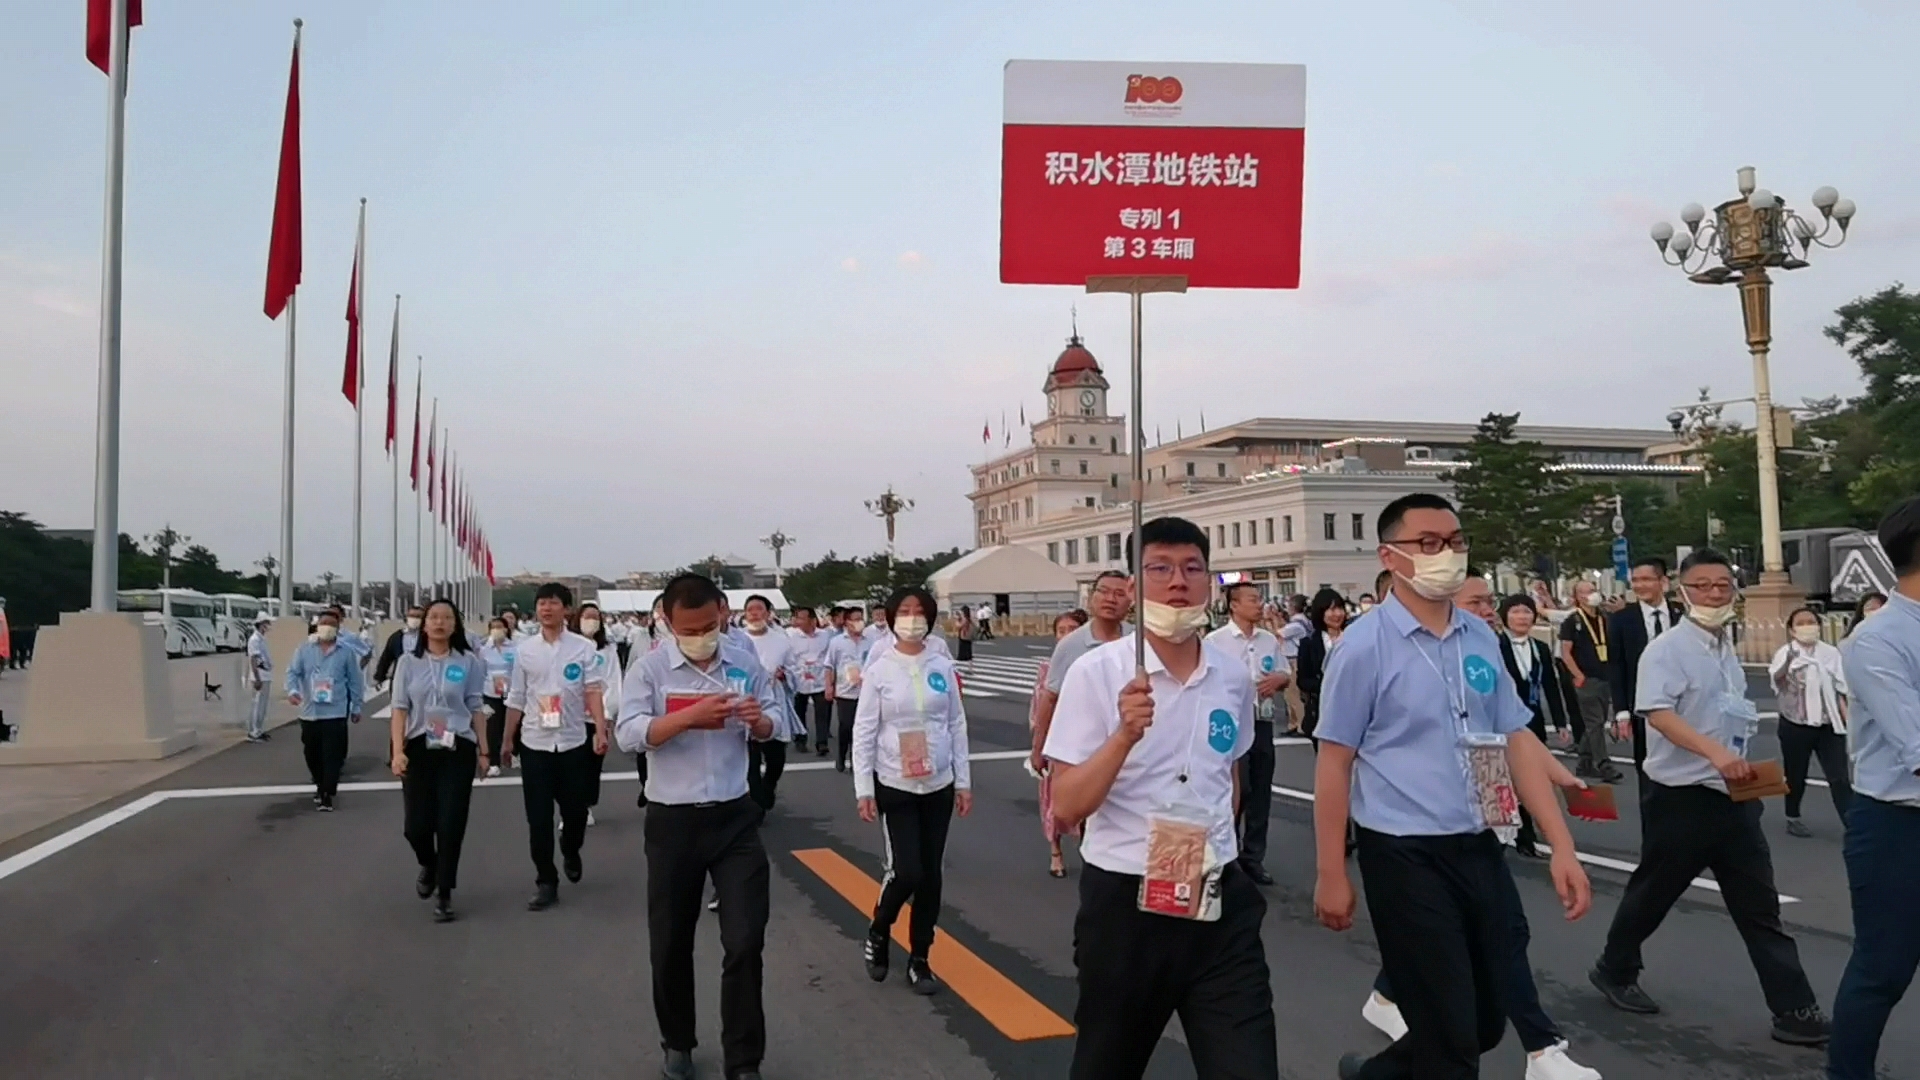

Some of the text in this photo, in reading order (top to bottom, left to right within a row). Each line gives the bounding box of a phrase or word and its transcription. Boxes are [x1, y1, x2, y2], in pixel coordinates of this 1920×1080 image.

[1045, 151, 1259, 188] 积水潭地铁站
